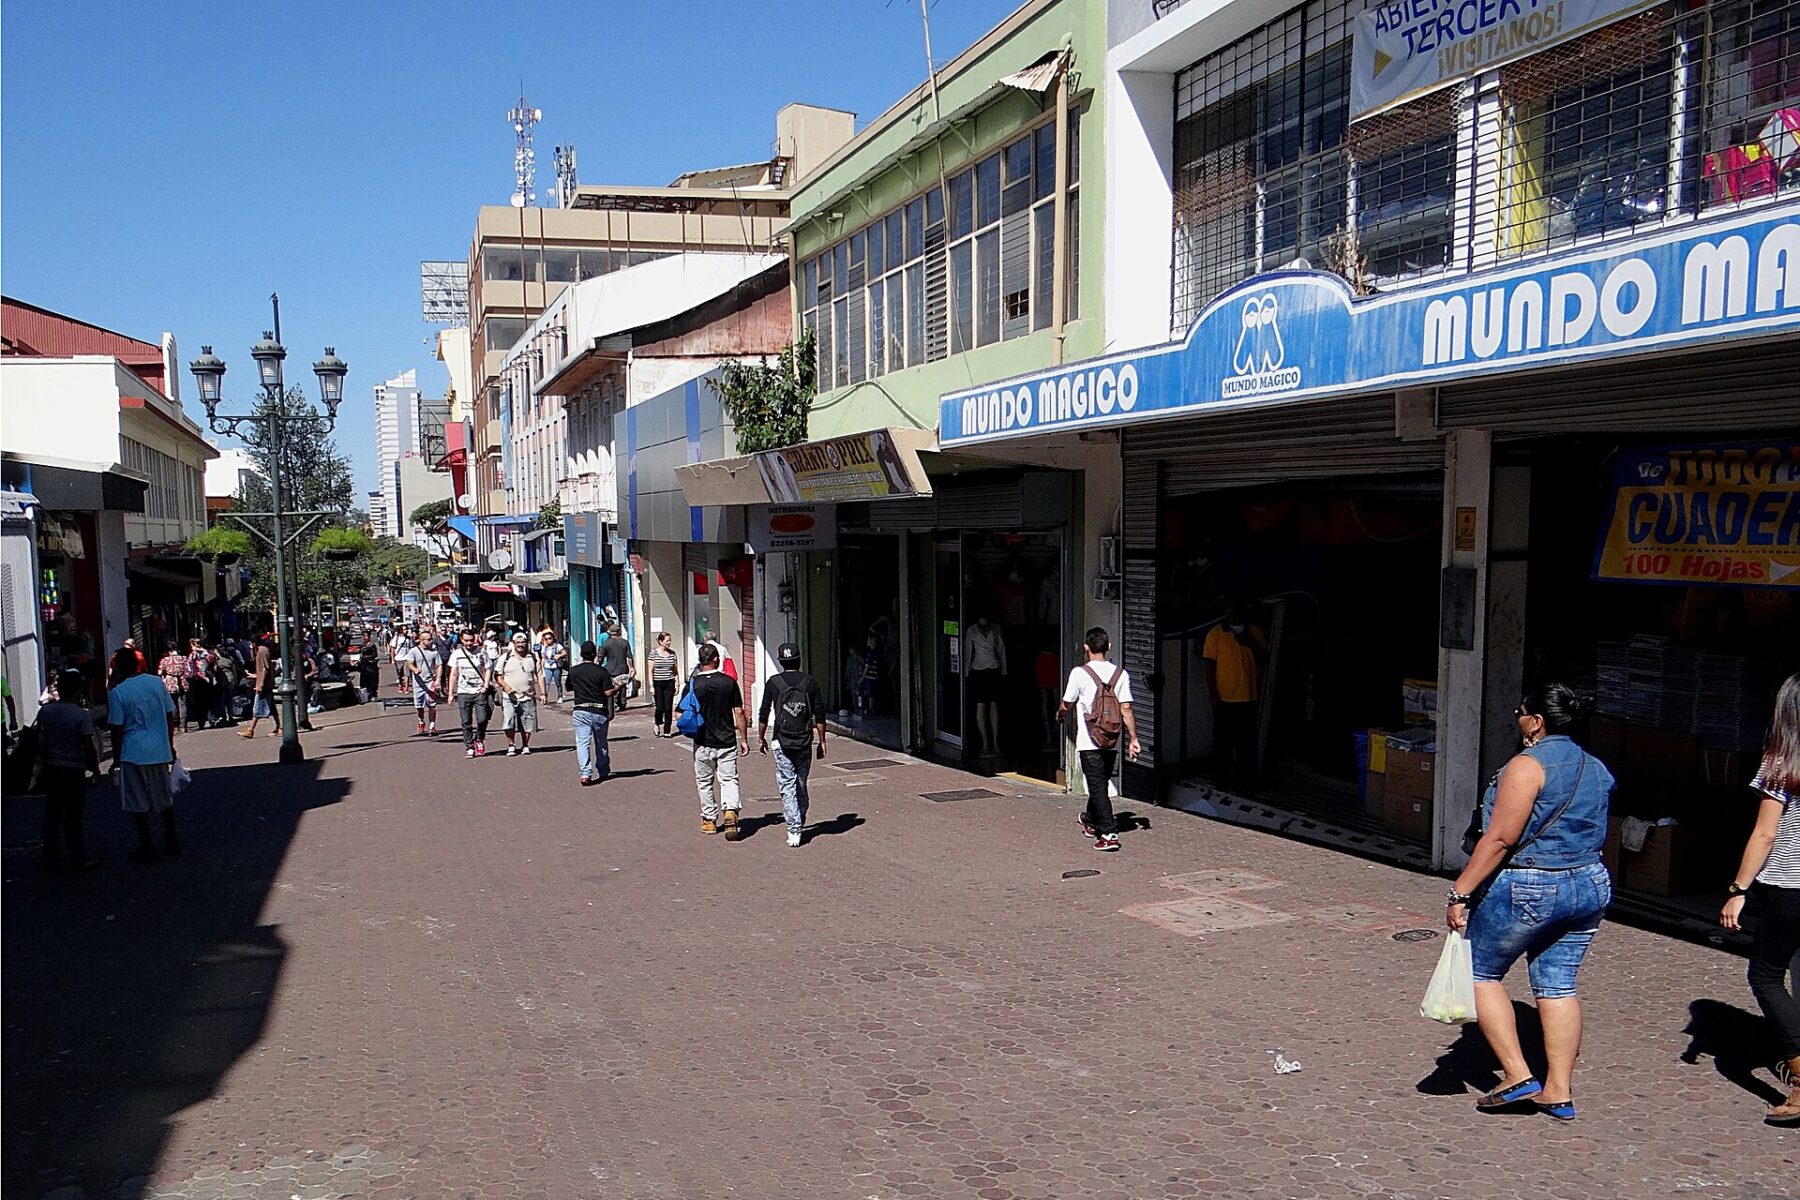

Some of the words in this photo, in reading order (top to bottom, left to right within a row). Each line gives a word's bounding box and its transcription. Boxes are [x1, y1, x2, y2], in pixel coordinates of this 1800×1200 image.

[1422, 258, 1657, 365] MUNDO
[961, 385, 1033, 436] MUNDO
[1038, 363, 1139, 424] MAGICO
[1224, 378, 1258, 394] MUNDO
[1259, 371, 1298, 389] MAGICO
[836, 436, 875, 467] PRIX
[1665, 447, 1782, 485] TODO
[1623, 554, 1672, 575] 100
[1679, 555, 1765, 581] Hojas
